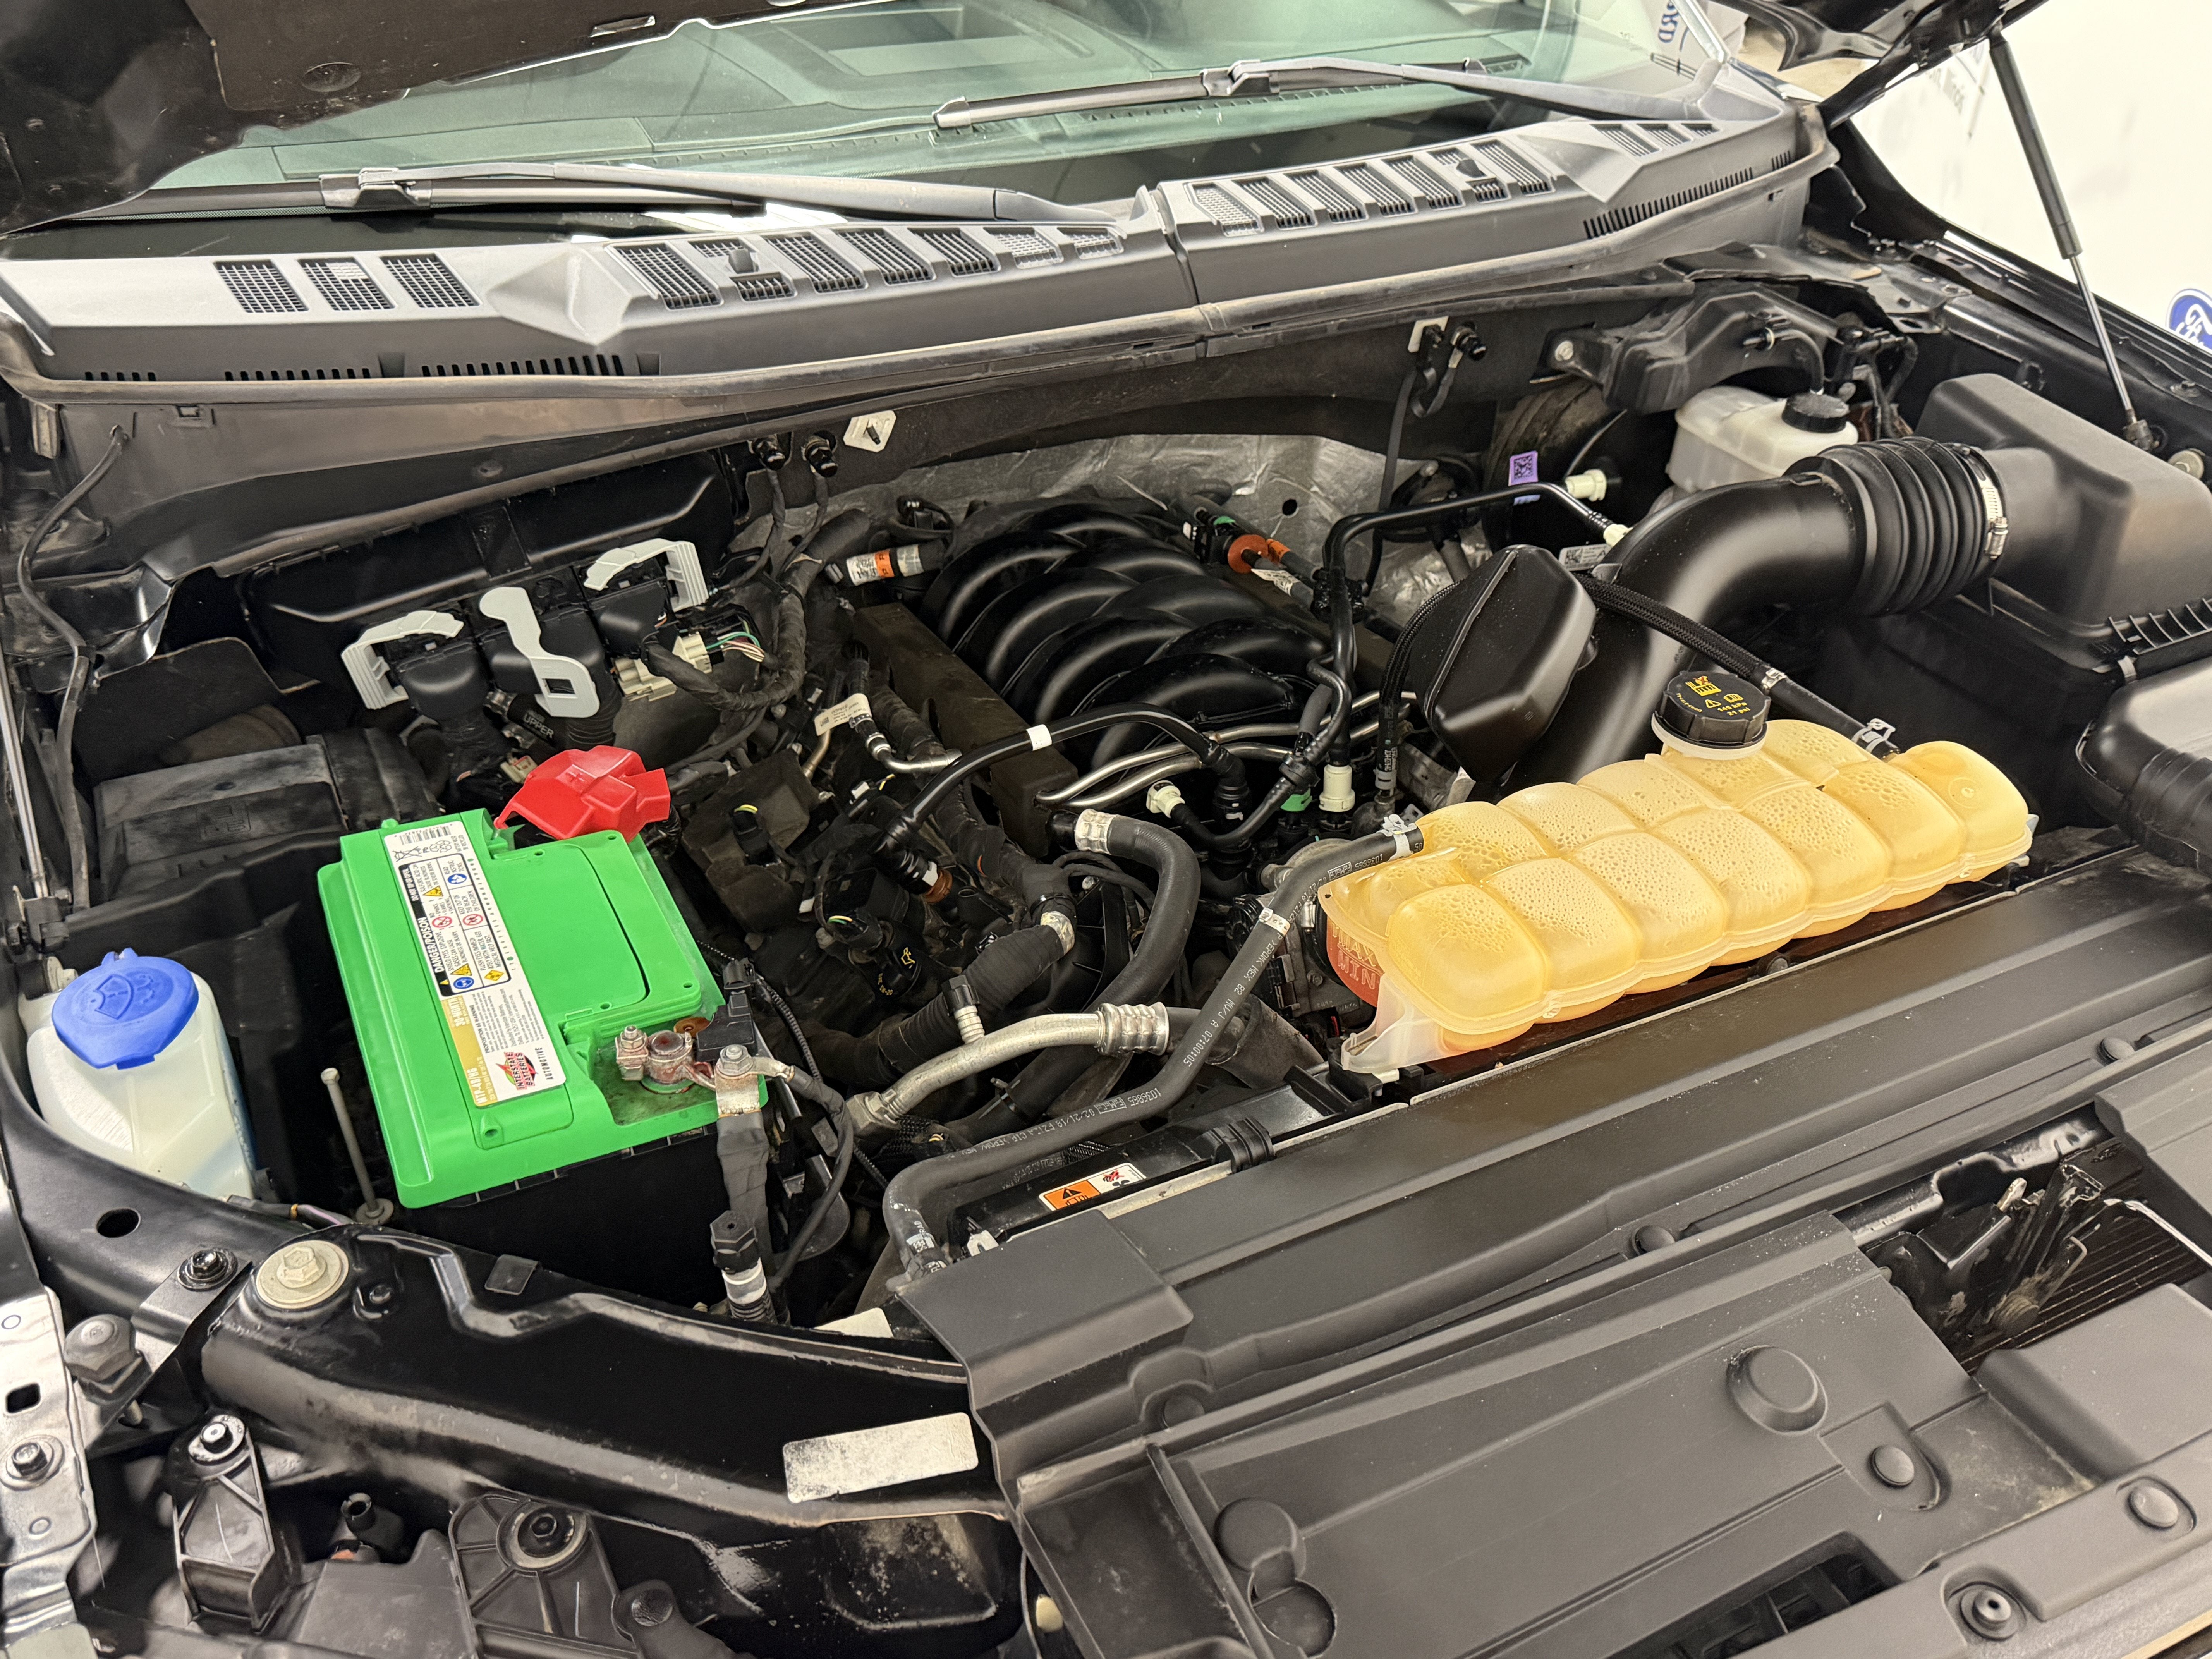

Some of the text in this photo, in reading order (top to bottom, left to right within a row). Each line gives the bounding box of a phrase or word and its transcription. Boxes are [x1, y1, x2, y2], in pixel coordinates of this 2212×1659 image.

[524, 716, 554, 738] UPPER
[1326, 861, 1354, 880] FoMoCo
[1354, 854, 1384, 870] 1036865
[417, 916, 445, 973] DANGER/POISON
[1338, 932, 1376, 967] MAX
[1242, 964, 1259, 982] MEX
[1338, 950, 1376, 989] MIN
[447, 997, 466, 1027] 30-MONTH
[469, 1004, 479, 1022] WARNING
[477, 1028, 491, 1053] PROPOSITION
[1182, 1028, 1212, 1068] 07:00:05
[505, 1052, 526, 1089] INTERSTATE
[514, 1052, 534, 1086] BATTERIES
[534, 1047, 554, 1080] AUTOMOTIVE
[1093, 1096, 1126, 1115] FoMoCo
[1126, 1087, 1161, 1106] 1036865
[1053, 1107, 1095, 1127] 02/21/18
[1010, 1131, 1027, 1142] CIP
